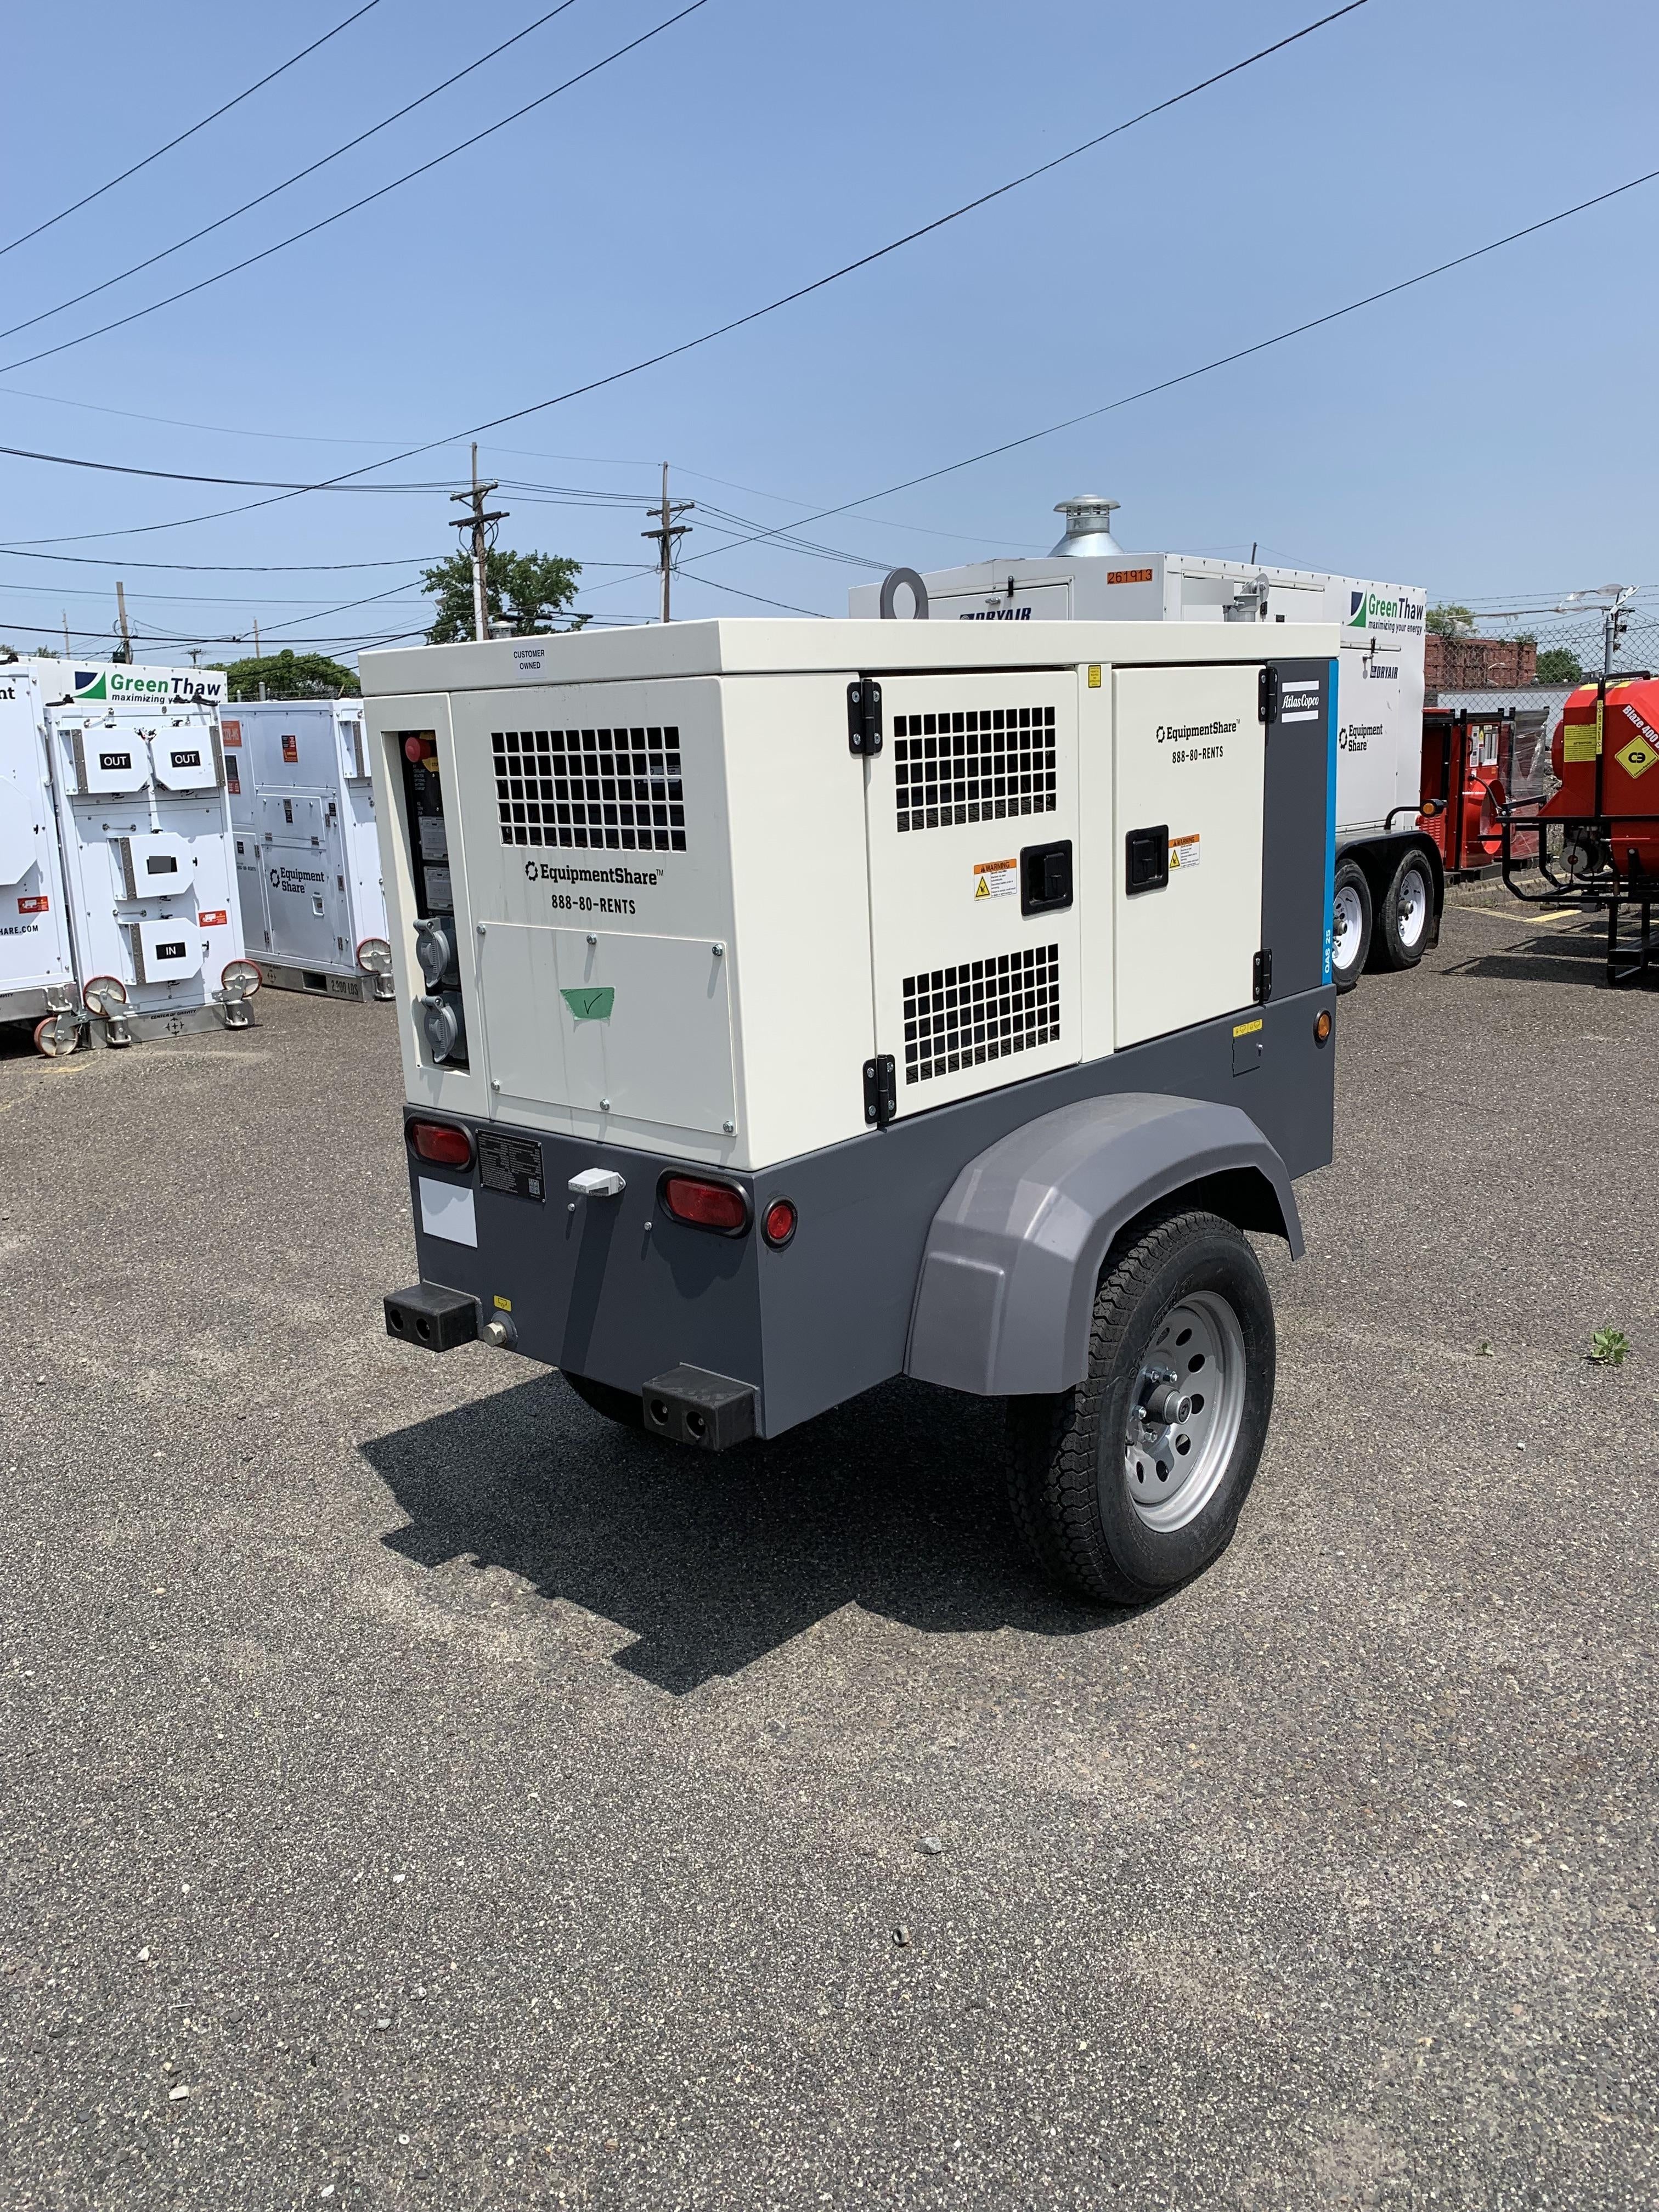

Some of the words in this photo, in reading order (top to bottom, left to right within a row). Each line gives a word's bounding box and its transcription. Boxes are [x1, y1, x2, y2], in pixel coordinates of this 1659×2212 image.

[1108, 569, 1152, 584] 261913
[1369, 593, 1424, 620] GreenThaw
[1368, 619, 1395, 633] maximizing
[1396, 623, 1406, 634] your
[1407, 623, 1423, 635] energy
[514, 649, 545, 658] CUSTOMER
[1376, 666, 1398, 679] DRYAIR
[112, 692, 165, 704] maximizing
[1282, 695, 1301, 709] Atlas
[1301, 693, 1319, 709] Copco
[1622, 704, 1644, 728] Blaze
[1641, 725, 1658, 743] 400
[1348, 724, 1383, 739] Equipment
[1348, 740, 1367, 752] Share
[104, 756, 127, 766] OUT
[174, 754, 196, 764] OUT
[1172, 746, 1223, 764] 888-80-RENTS
[986, 861, 1010, 871] WARNING
[280, 867, 325, 882] Equipment
[282, 881, 305, 893] Share
[551, 894, 636, 915] 888-80-RENTS
[1325, 929, 1330, 944] 25
[166, 946, 177, 956] IN
